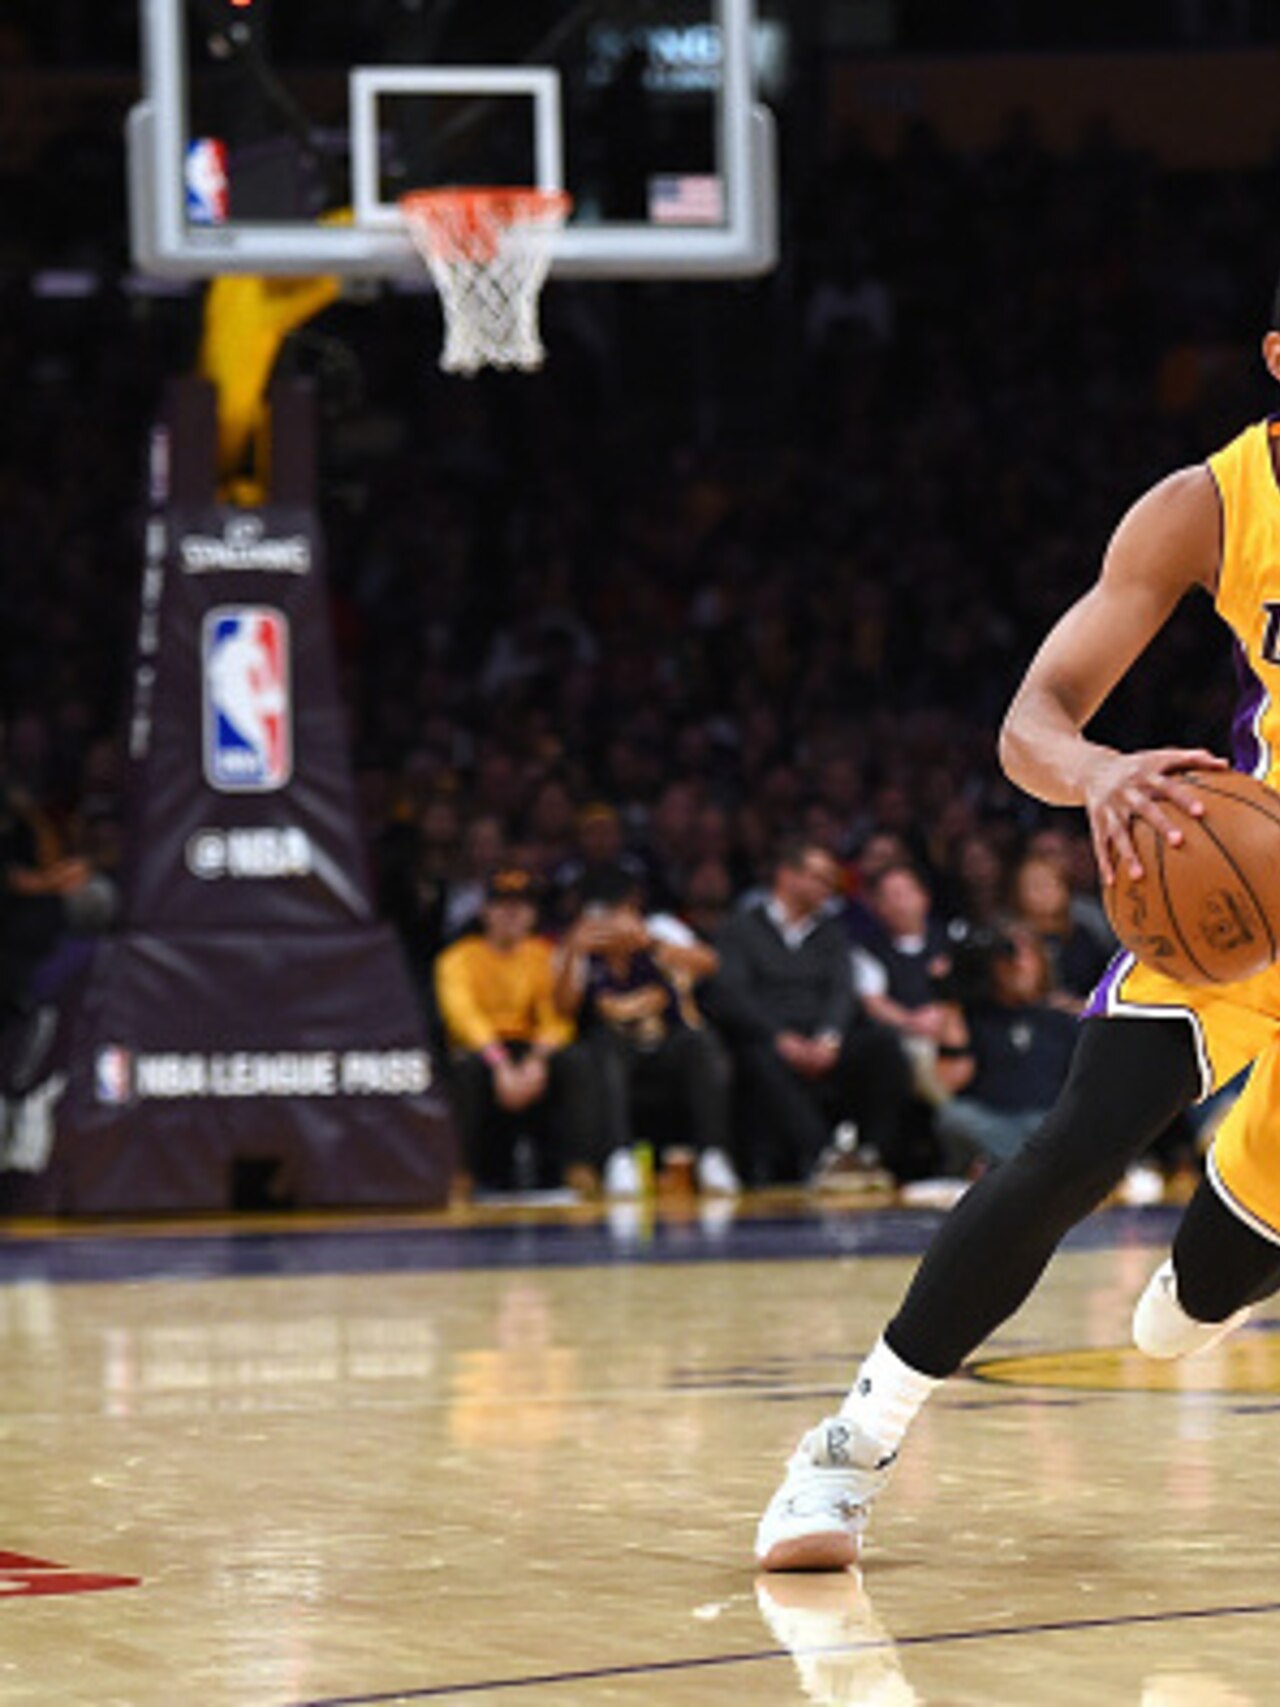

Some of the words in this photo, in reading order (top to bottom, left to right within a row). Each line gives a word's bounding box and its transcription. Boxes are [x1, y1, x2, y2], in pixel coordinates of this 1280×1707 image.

[188, 827, 311, 879] @NBA
[136, 1052, 206, 1095] NBA
[210, 1051, 336, 1095] LEAGUE
[342, 1049, 431, 1095] PASS
